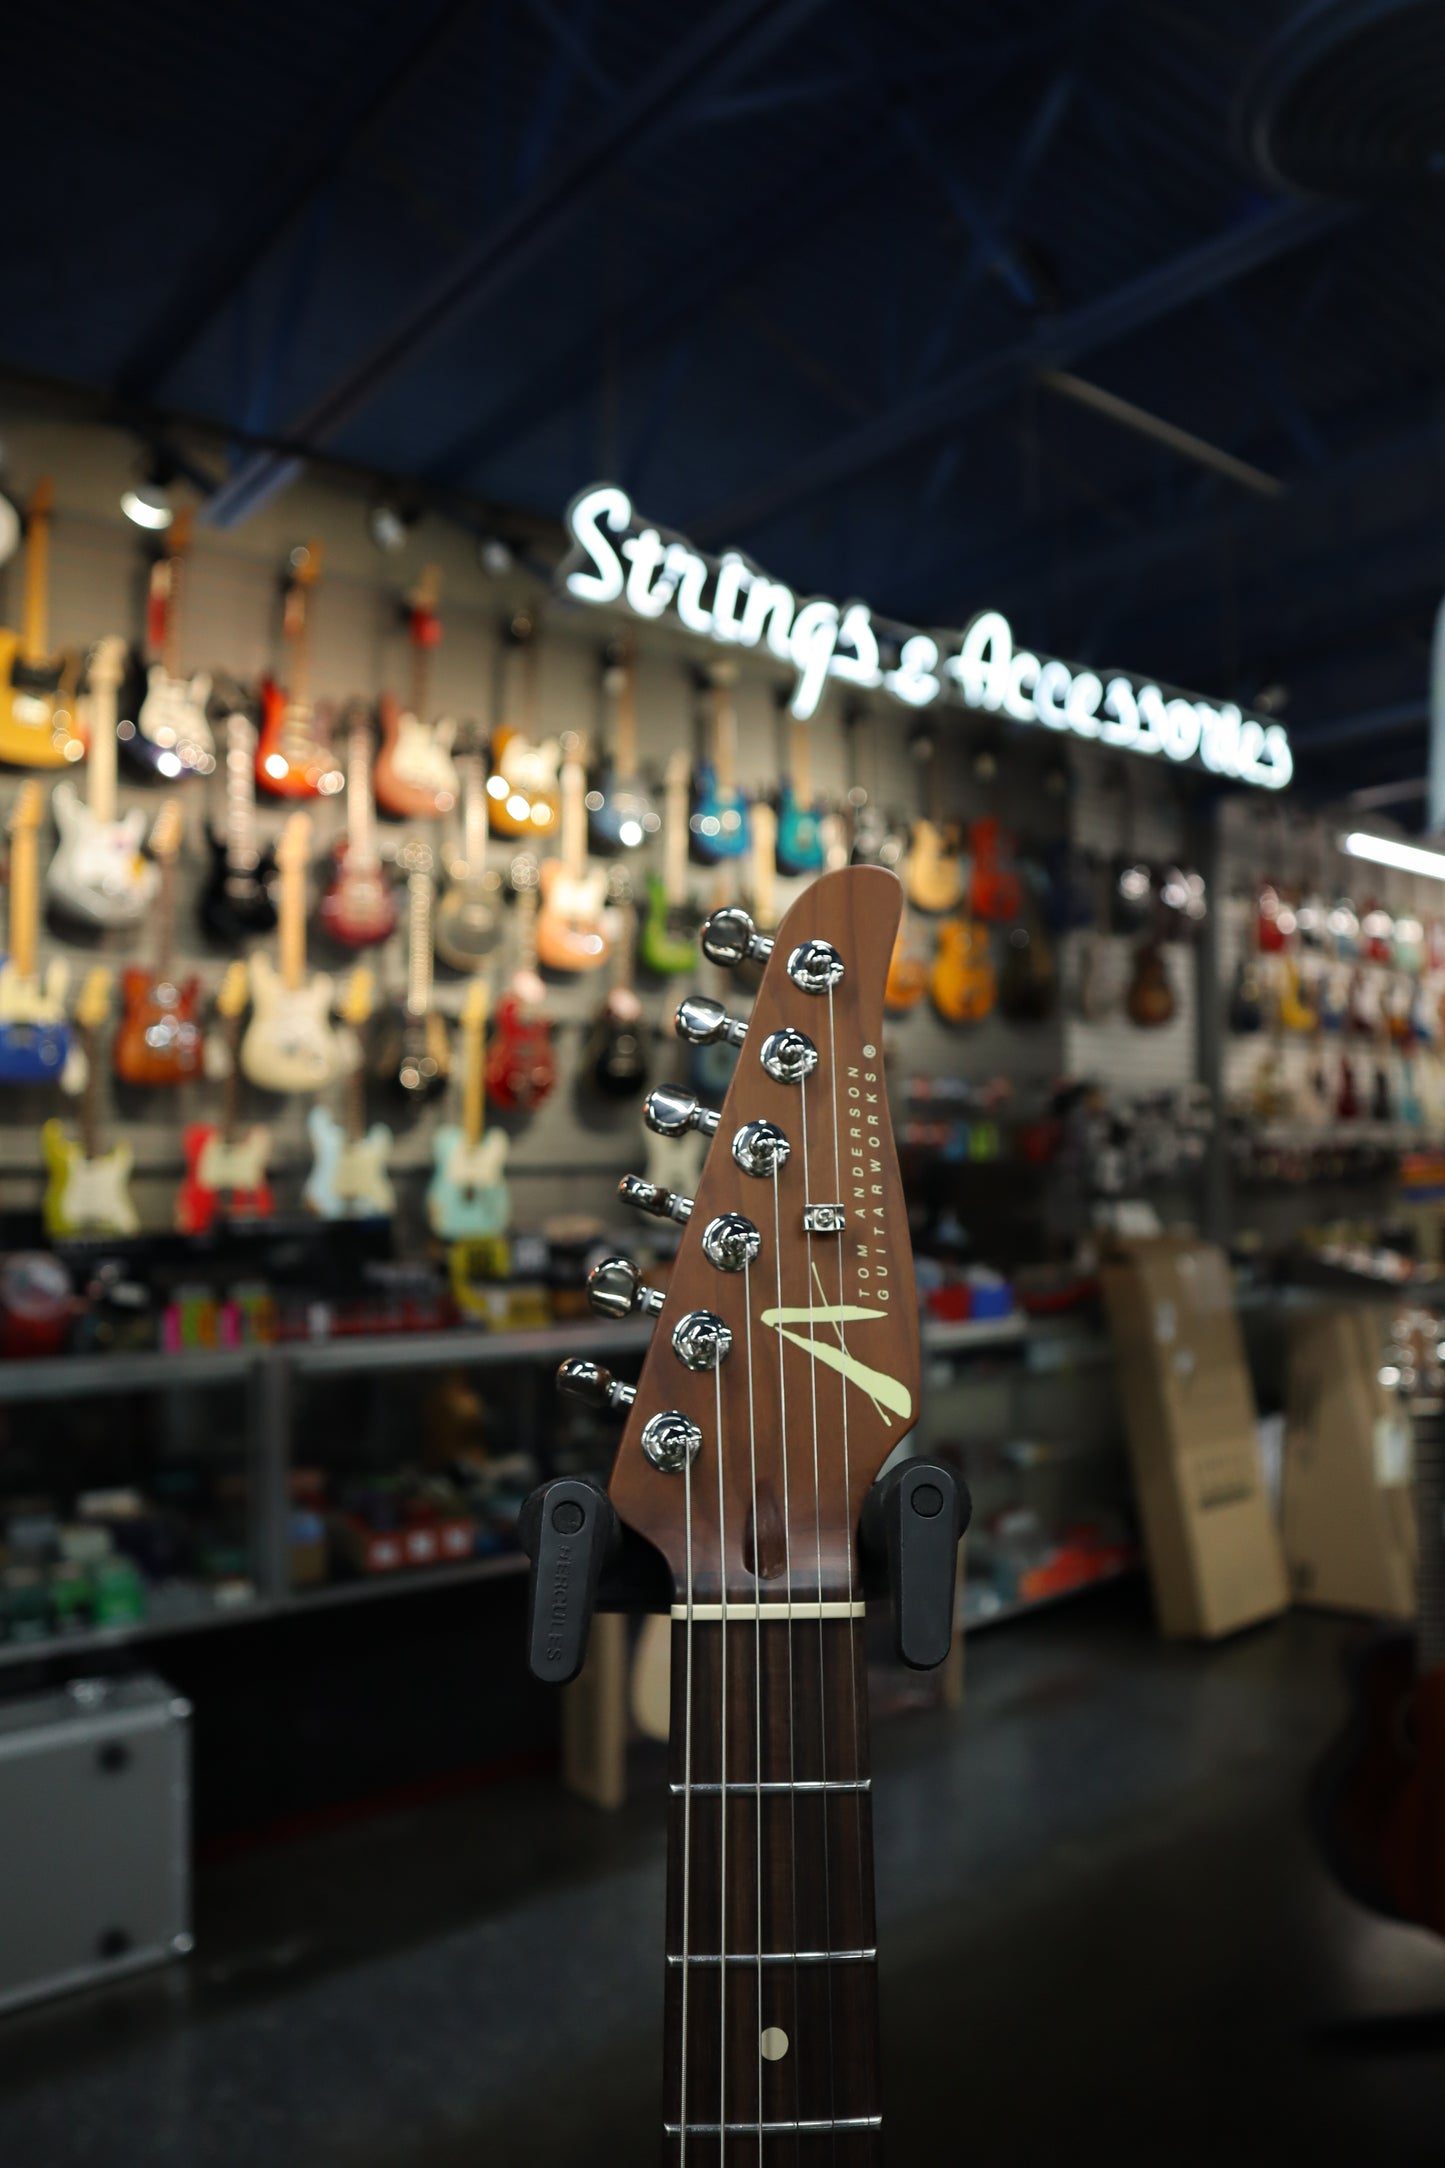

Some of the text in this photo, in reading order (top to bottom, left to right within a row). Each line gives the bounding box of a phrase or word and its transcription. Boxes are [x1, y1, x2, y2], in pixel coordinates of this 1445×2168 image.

[567, 488, 1294, 790] Strings & Accessories
[848, 1066, 871, 1298] TOM ANDERSON
[546, 1544, 572, 1662] HERCULES
